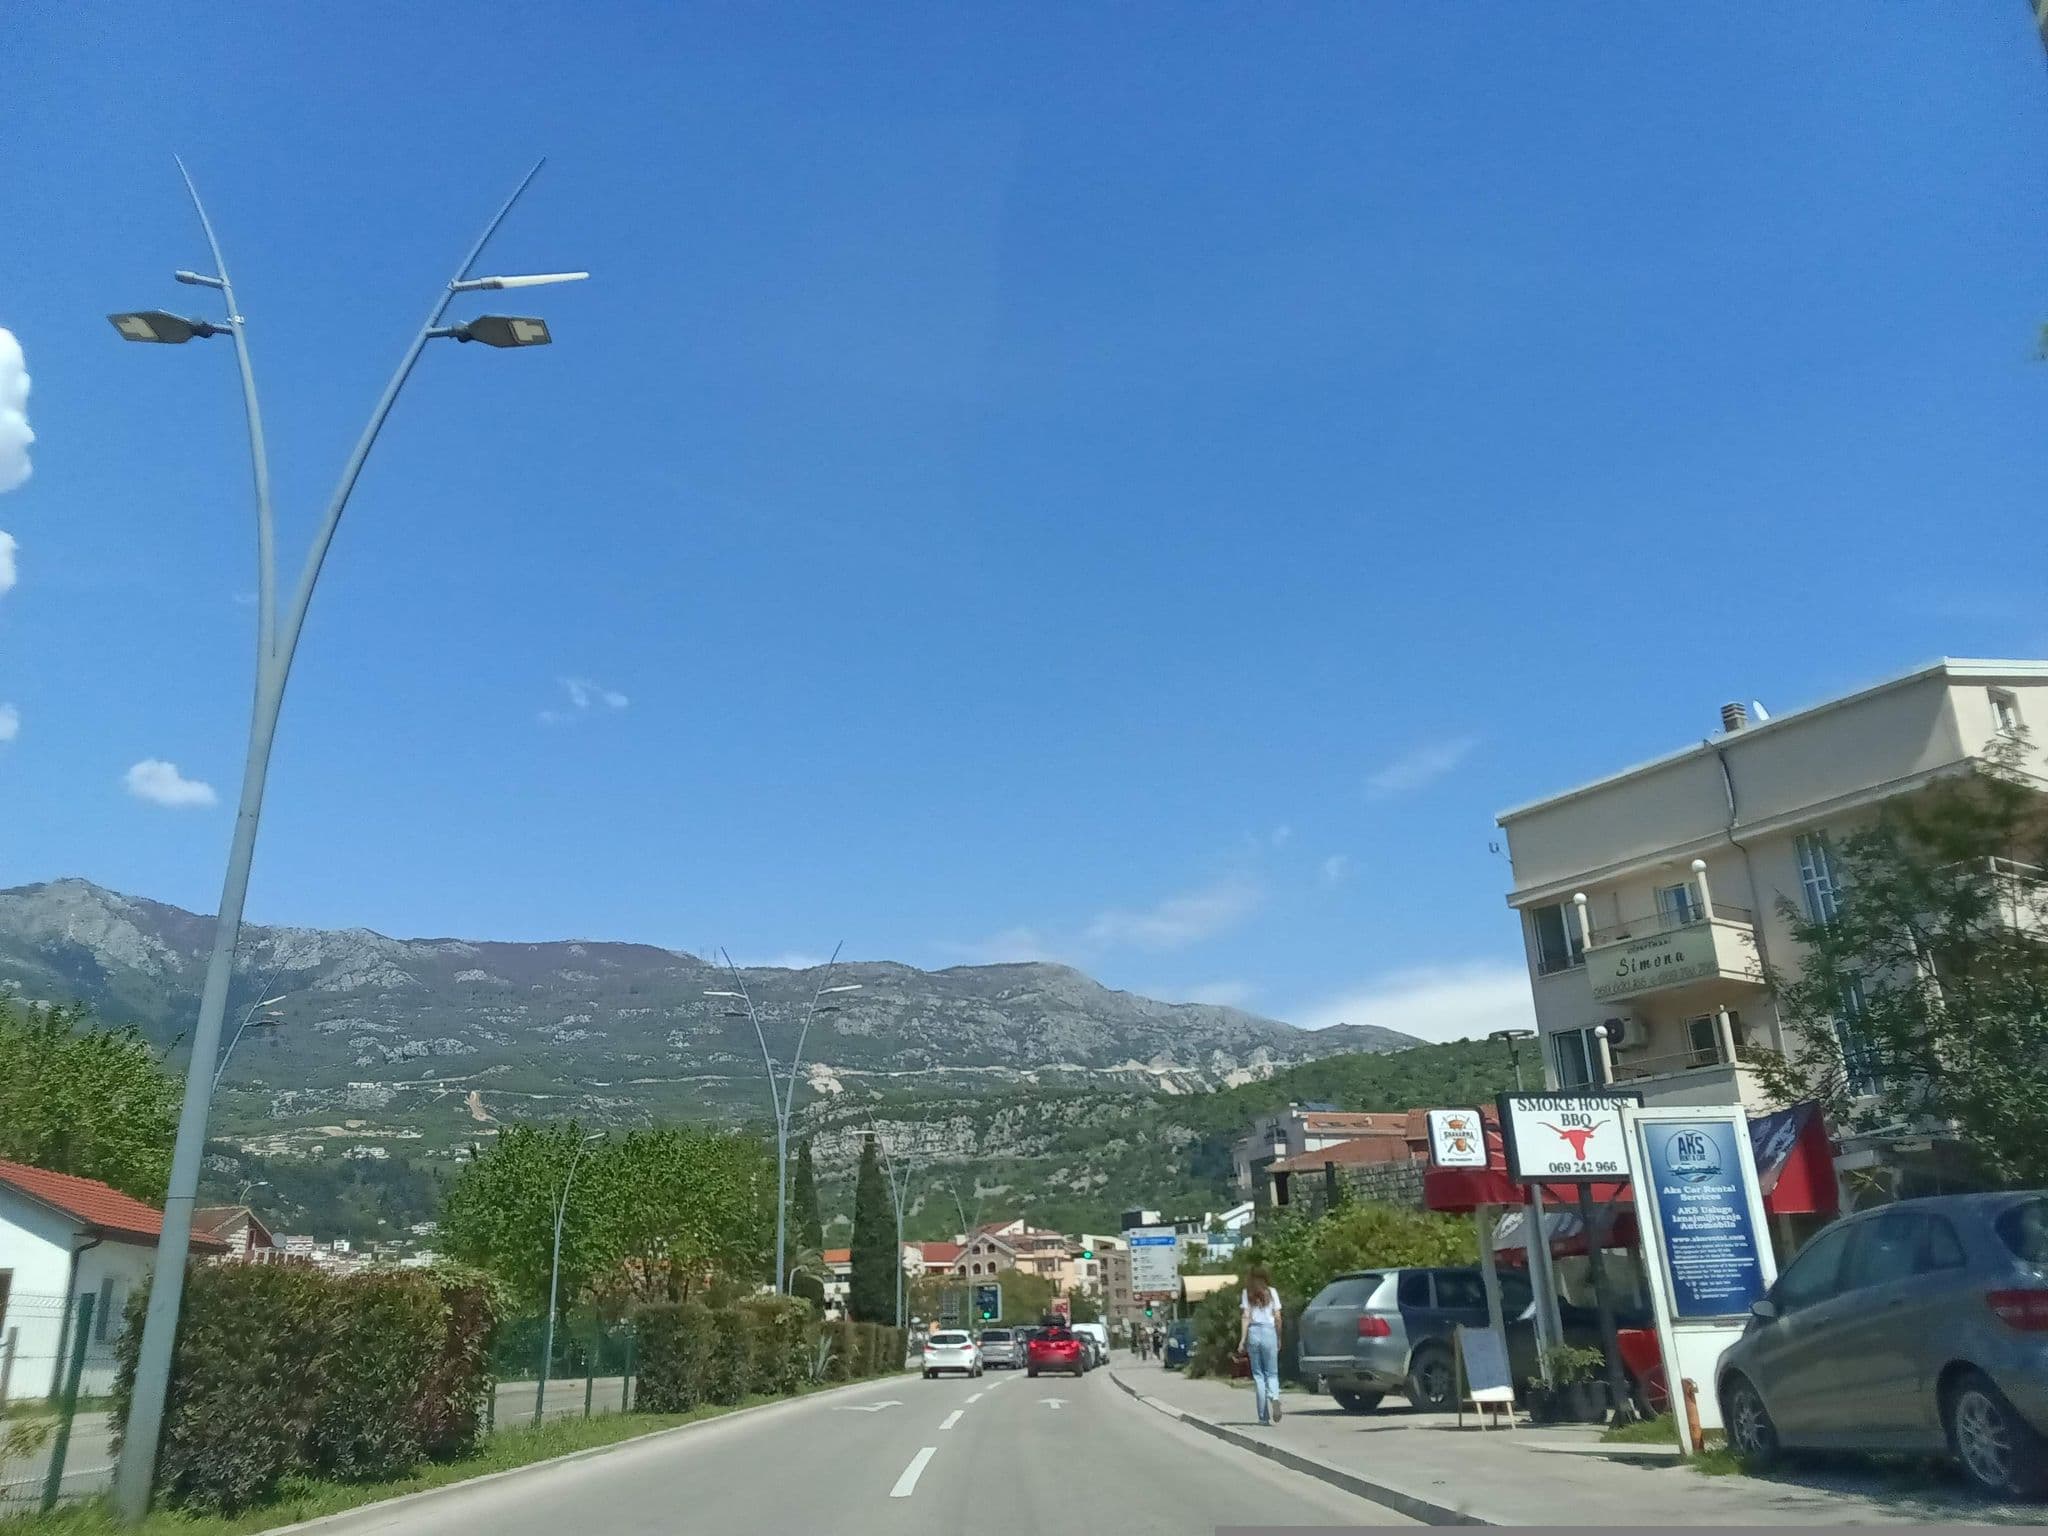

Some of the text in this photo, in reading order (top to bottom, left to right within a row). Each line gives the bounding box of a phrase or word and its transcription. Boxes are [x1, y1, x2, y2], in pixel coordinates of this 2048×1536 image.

[1616, 951, 1685, 976] Simona
[1517, 1098, 1575, 1111] SMOKE
[1561, 1113, 1593, 1129] BBQ
[1678, 1136, 1705, 1155] AKS
[1549, 1161, 1617, 1173] 069 242 966
[1683, 1186, 1701, 1194] Car
[1703, 1184, 1737, 1192] Rental
[1678, 1207, 1699, 1215] AKS
